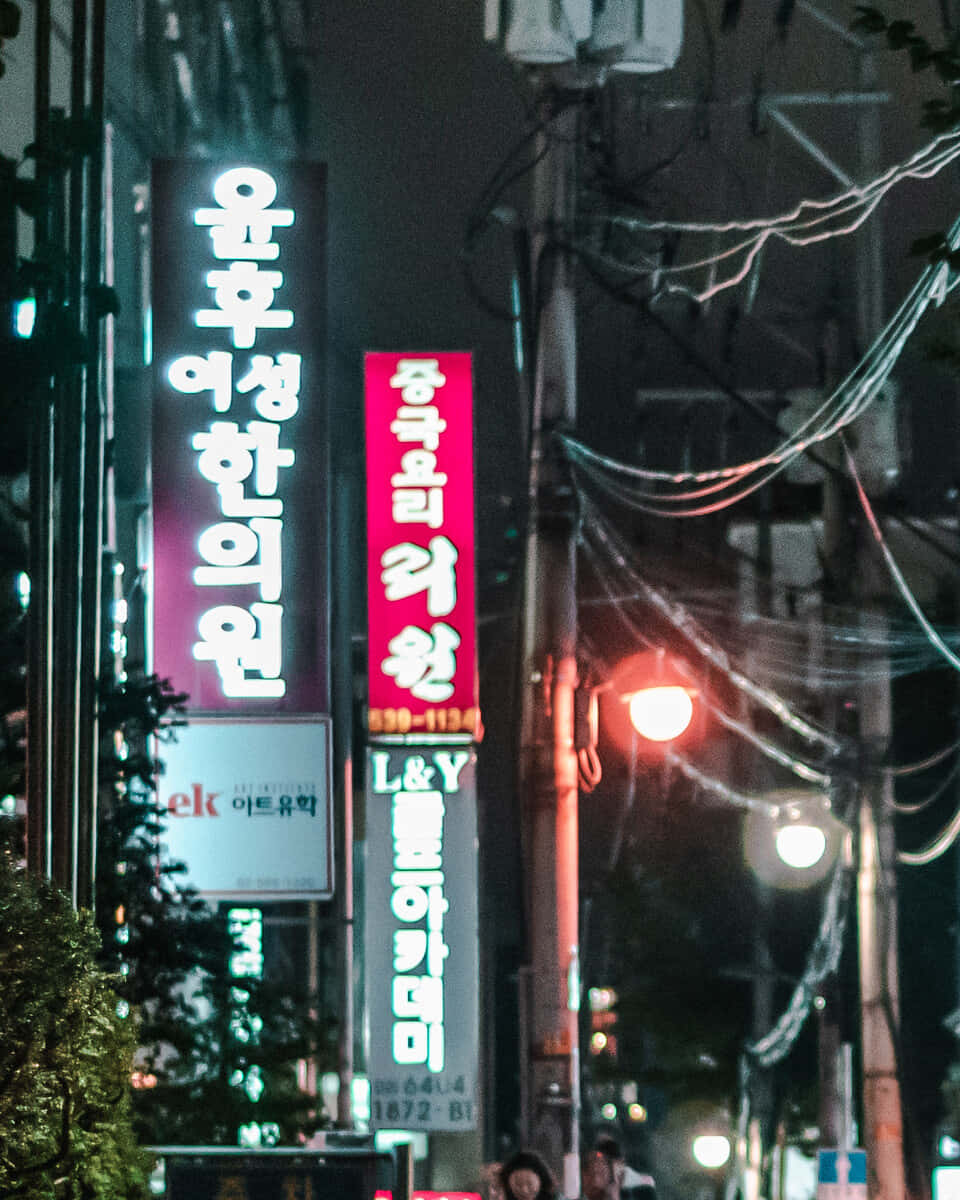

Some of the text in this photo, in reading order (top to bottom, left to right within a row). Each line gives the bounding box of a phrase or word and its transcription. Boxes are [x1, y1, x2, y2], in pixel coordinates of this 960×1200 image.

[388, 358, 449, 530] 중국요리
[371, 751, 470, 793] L&Y
[232, 793, 318, 818] 아트유학
